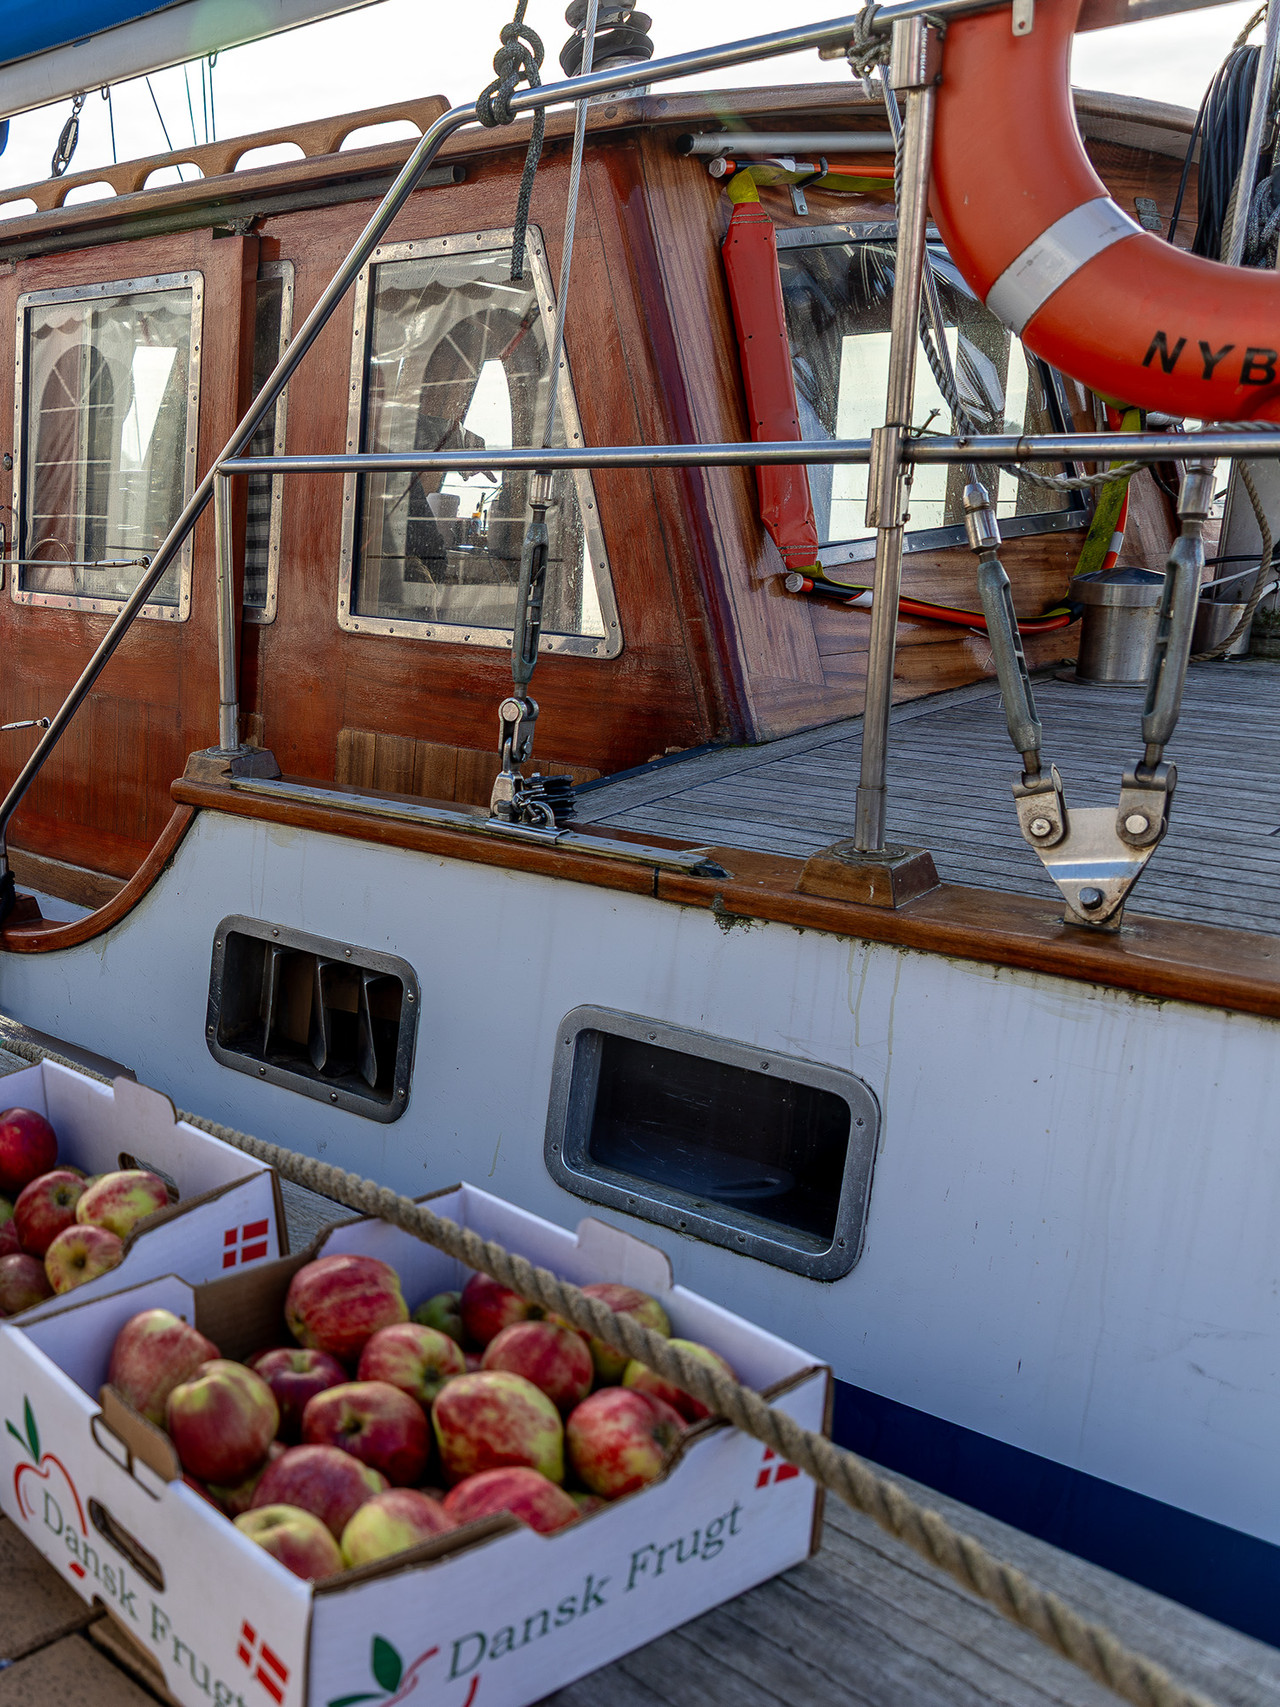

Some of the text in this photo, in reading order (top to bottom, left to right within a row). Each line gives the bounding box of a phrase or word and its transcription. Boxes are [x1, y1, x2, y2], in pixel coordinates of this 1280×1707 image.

[1142, 330, 1278, 386] NYB
[43, 1488, 140, 1622] Dansk
[447, 1499, 743, 1683] Dansk Frugt
